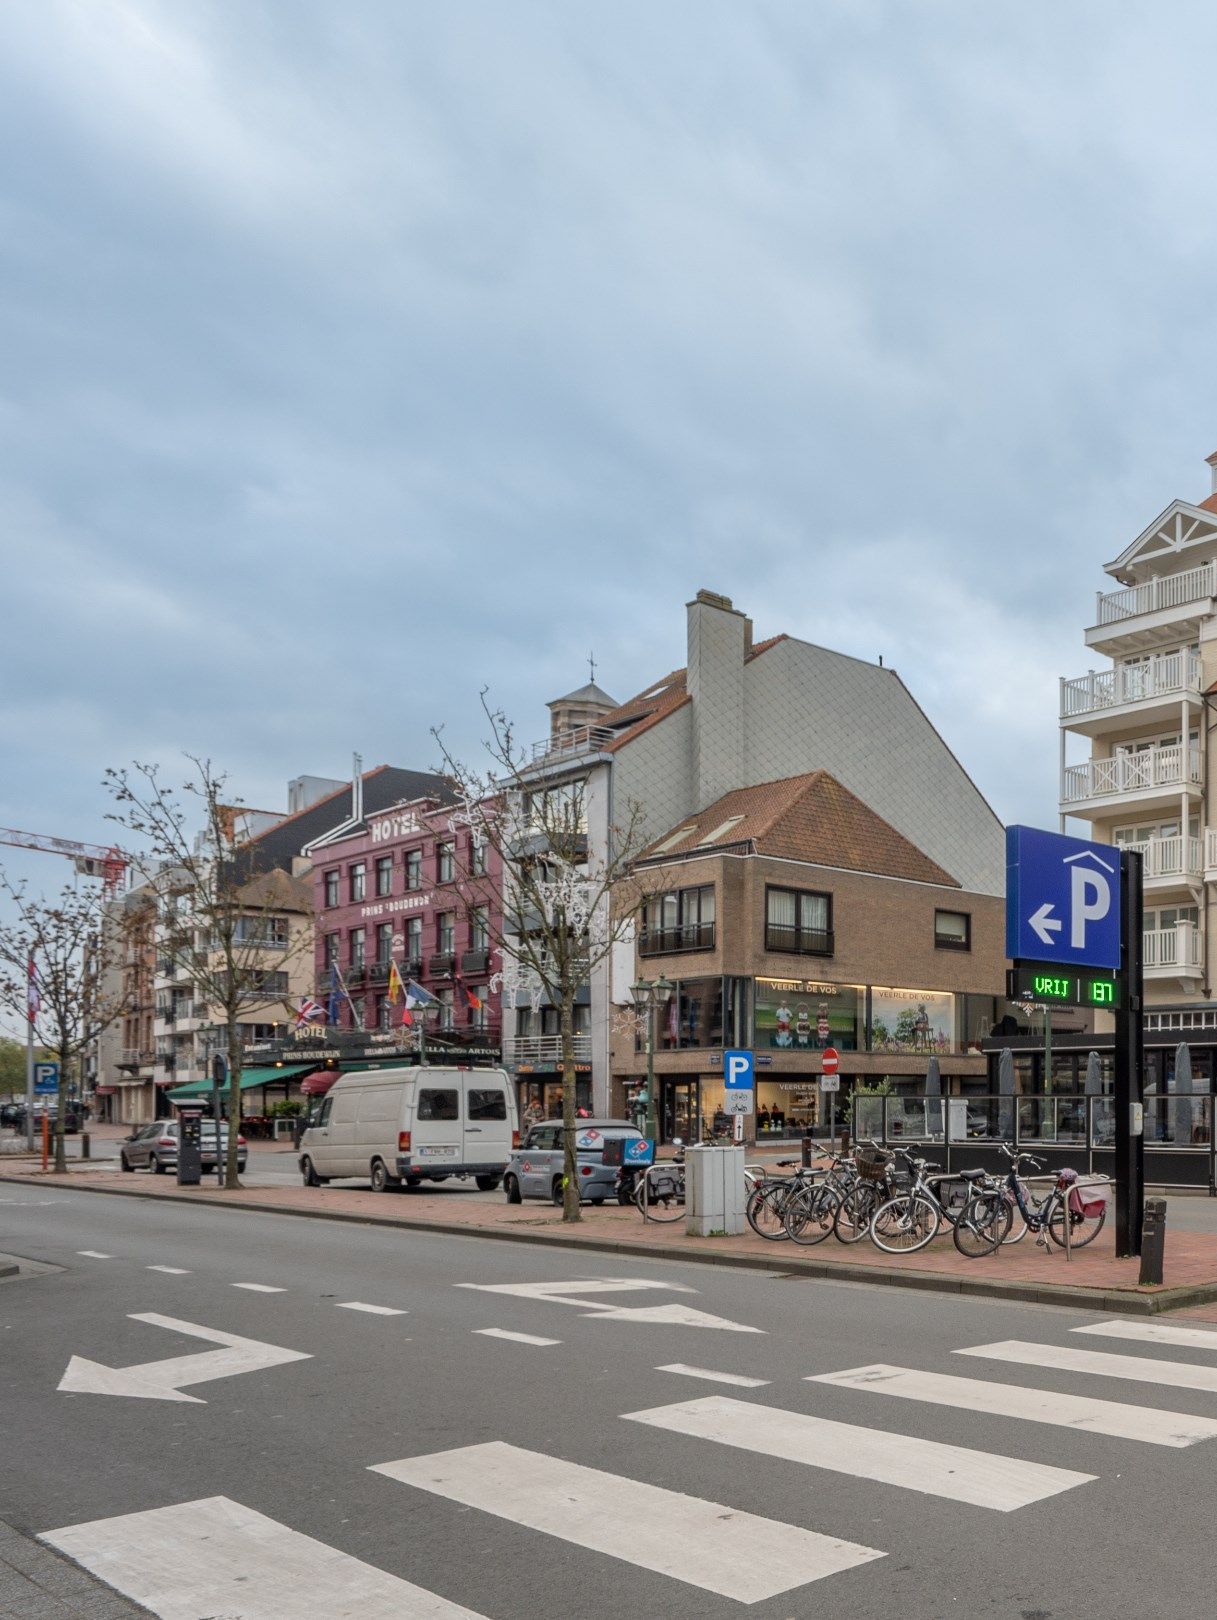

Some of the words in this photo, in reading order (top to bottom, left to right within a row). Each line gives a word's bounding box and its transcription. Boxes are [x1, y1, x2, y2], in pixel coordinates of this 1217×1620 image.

[372, 812, 421, 843] HOTEL
[361, 904, 383, 918] PRINS
[1071, 865, 1111, 949] P
[771, 982, 803, 992] VEERLE
[806, 985, 818, 993] DE
[819, 986, 837, 995] VOS
[1035, 977, 1069, 997] VRIJ
[879, 990, 907, 1000] VEERLE
[909, 992, 919, 1000] DE
[920, 993, 936, 1001] VOS
[294, 1026, 328, 1040] HOTEL
[282, 1051, 302, 1060] PRINS
[467, 1047, 501, 1056] ARTOIS
[37, 1066, 56, 1083] P
[556, 1064, 591, 1072] Qttro
[729, 1056, 750, 1084] P
[779, 1083, 807, 1091] VEERLE
